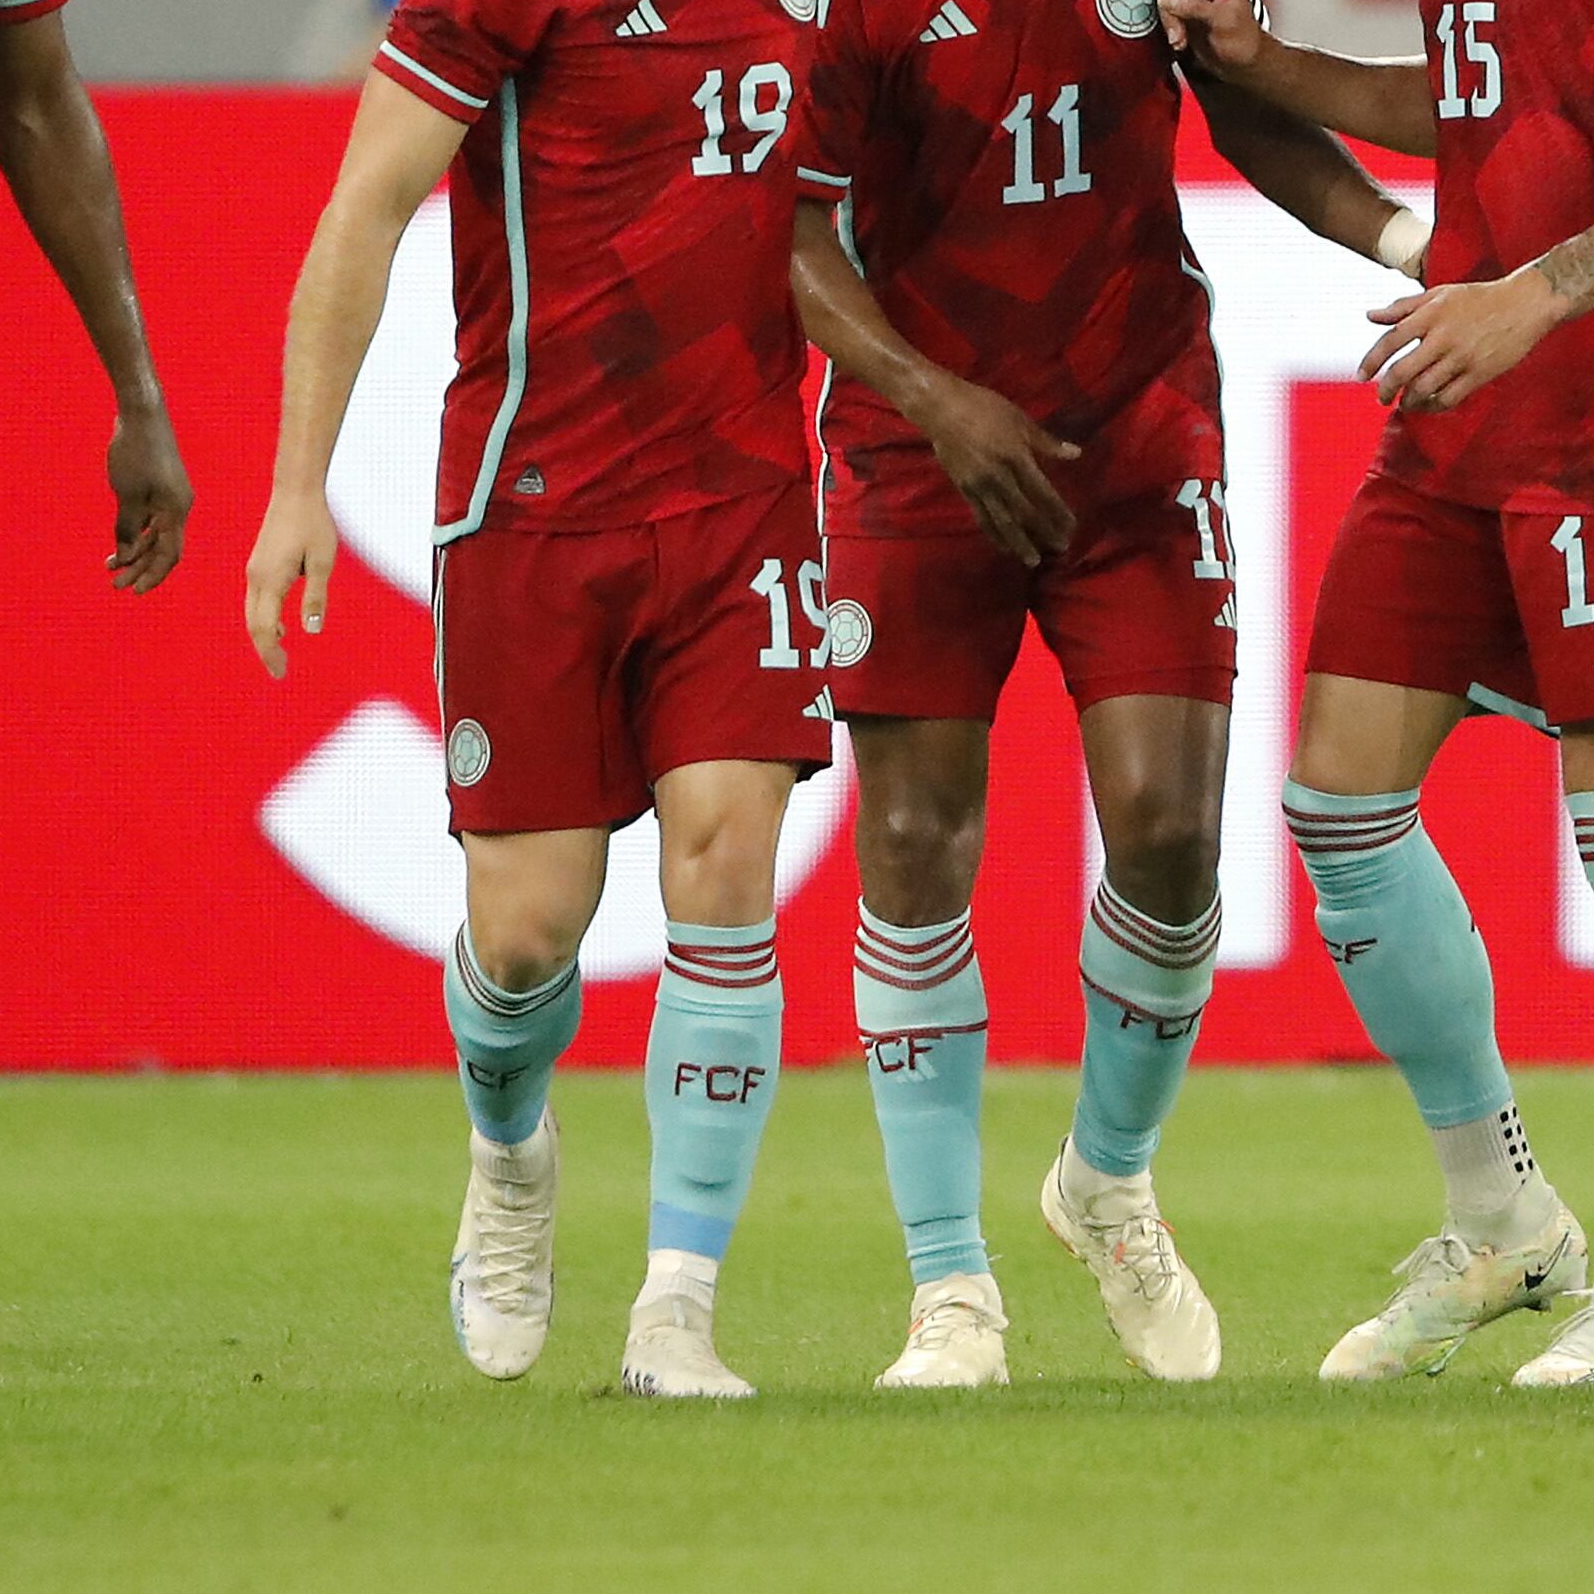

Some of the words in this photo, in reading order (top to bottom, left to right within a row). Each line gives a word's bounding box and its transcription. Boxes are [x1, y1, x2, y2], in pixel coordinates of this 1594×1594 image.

[1436, 2, 1504, 119] 15
[691, 62, 793, 176] 19
[1002, 84, 1092, 204] 11
[749, 558, 830, 668] 19
[674, 1061, 766, 1104] FCF
